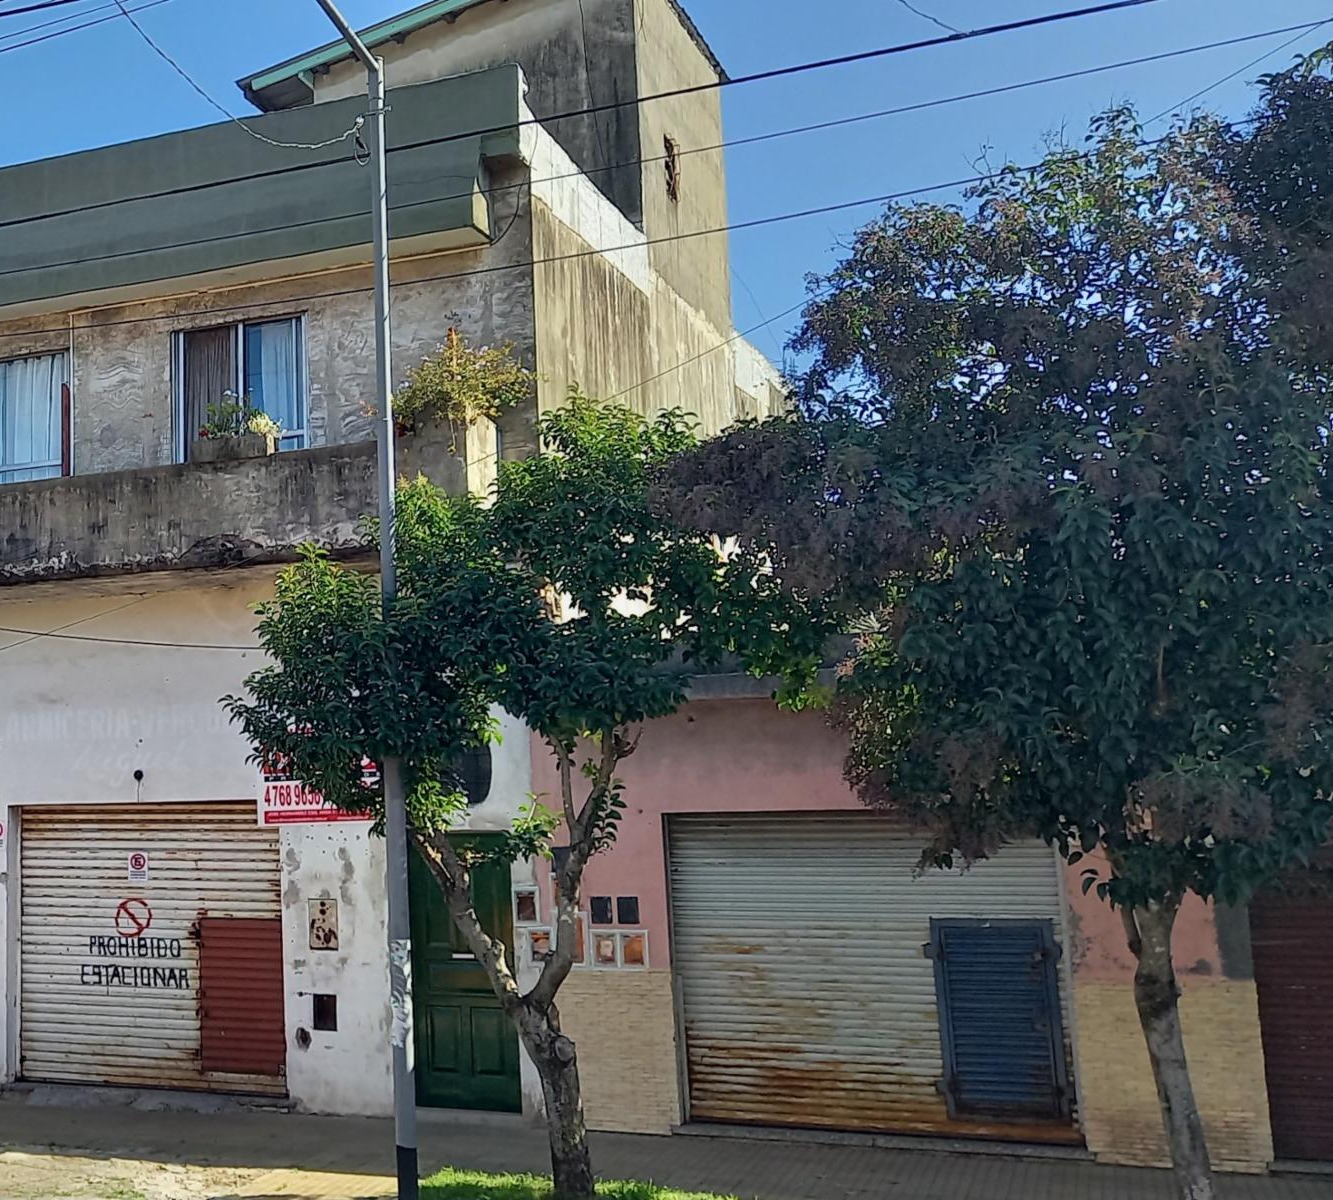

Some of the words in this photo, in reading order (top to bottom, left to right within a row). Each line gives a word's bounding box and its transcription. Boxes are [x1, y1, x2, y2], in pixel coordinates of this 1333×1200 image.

[264, 784, 291, 807] 4768
[89, 935, 181, 958] PROHIBIDO
[81, 964, 190, 989] ESTACIONAR
